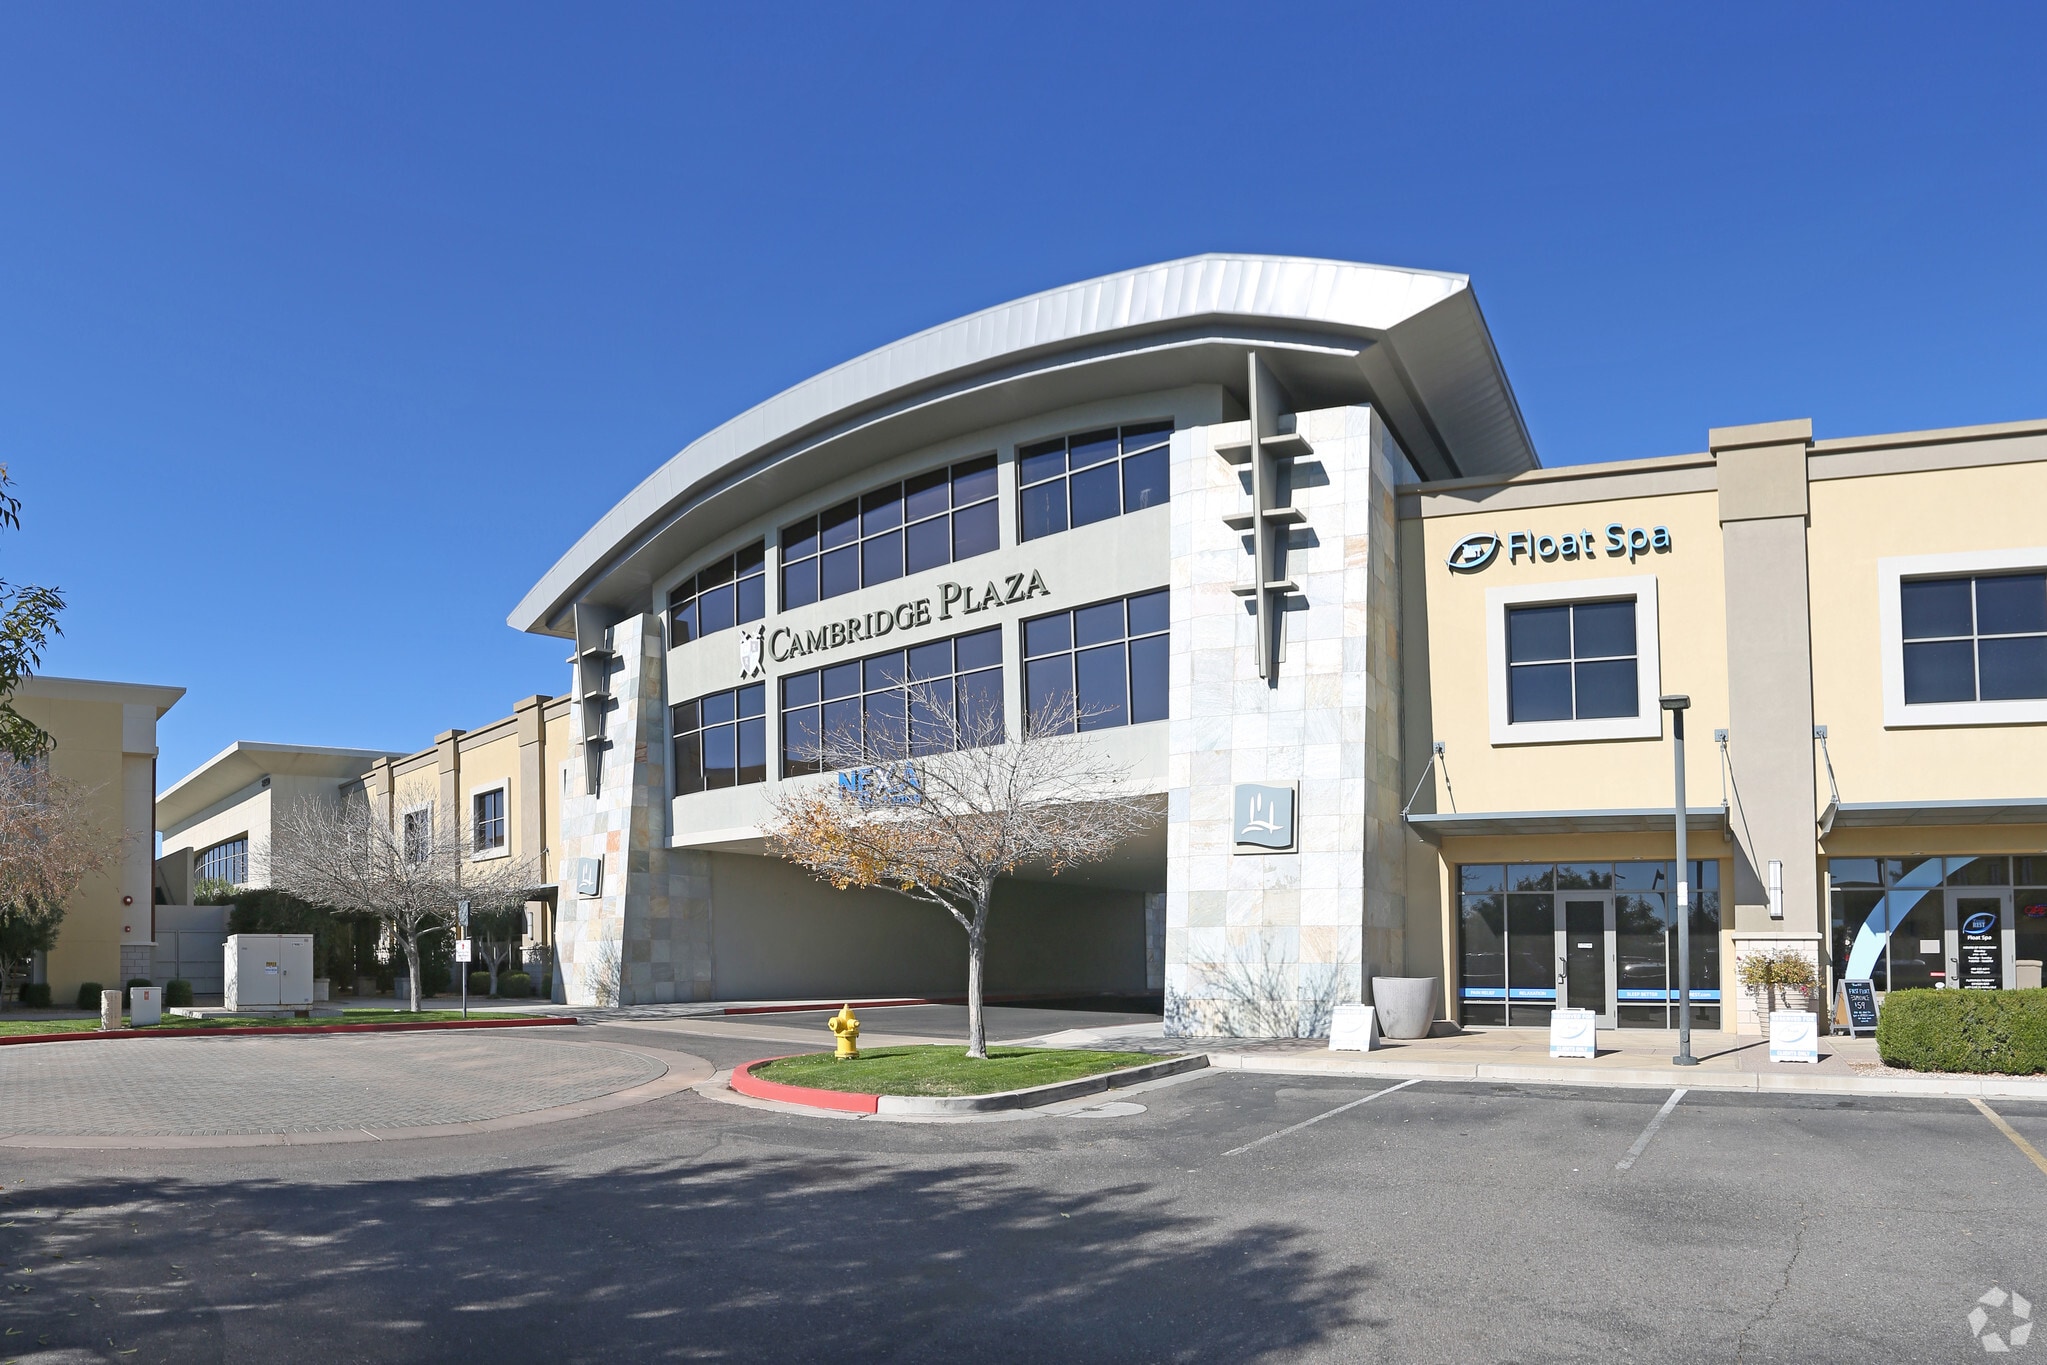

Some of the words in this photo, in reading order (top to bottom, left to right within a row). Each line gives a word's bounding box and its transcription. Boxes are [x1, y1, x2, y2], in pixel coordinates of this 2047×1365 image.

[1508, 529, 1594, 560] Float
[1605, 522, 1671, 559] Spa
[768, 598, 932, 662] CAMBRIDGE
[937, 568, 1051, 620] PLAZA
[2024, 904, 2047, 916] OPE
